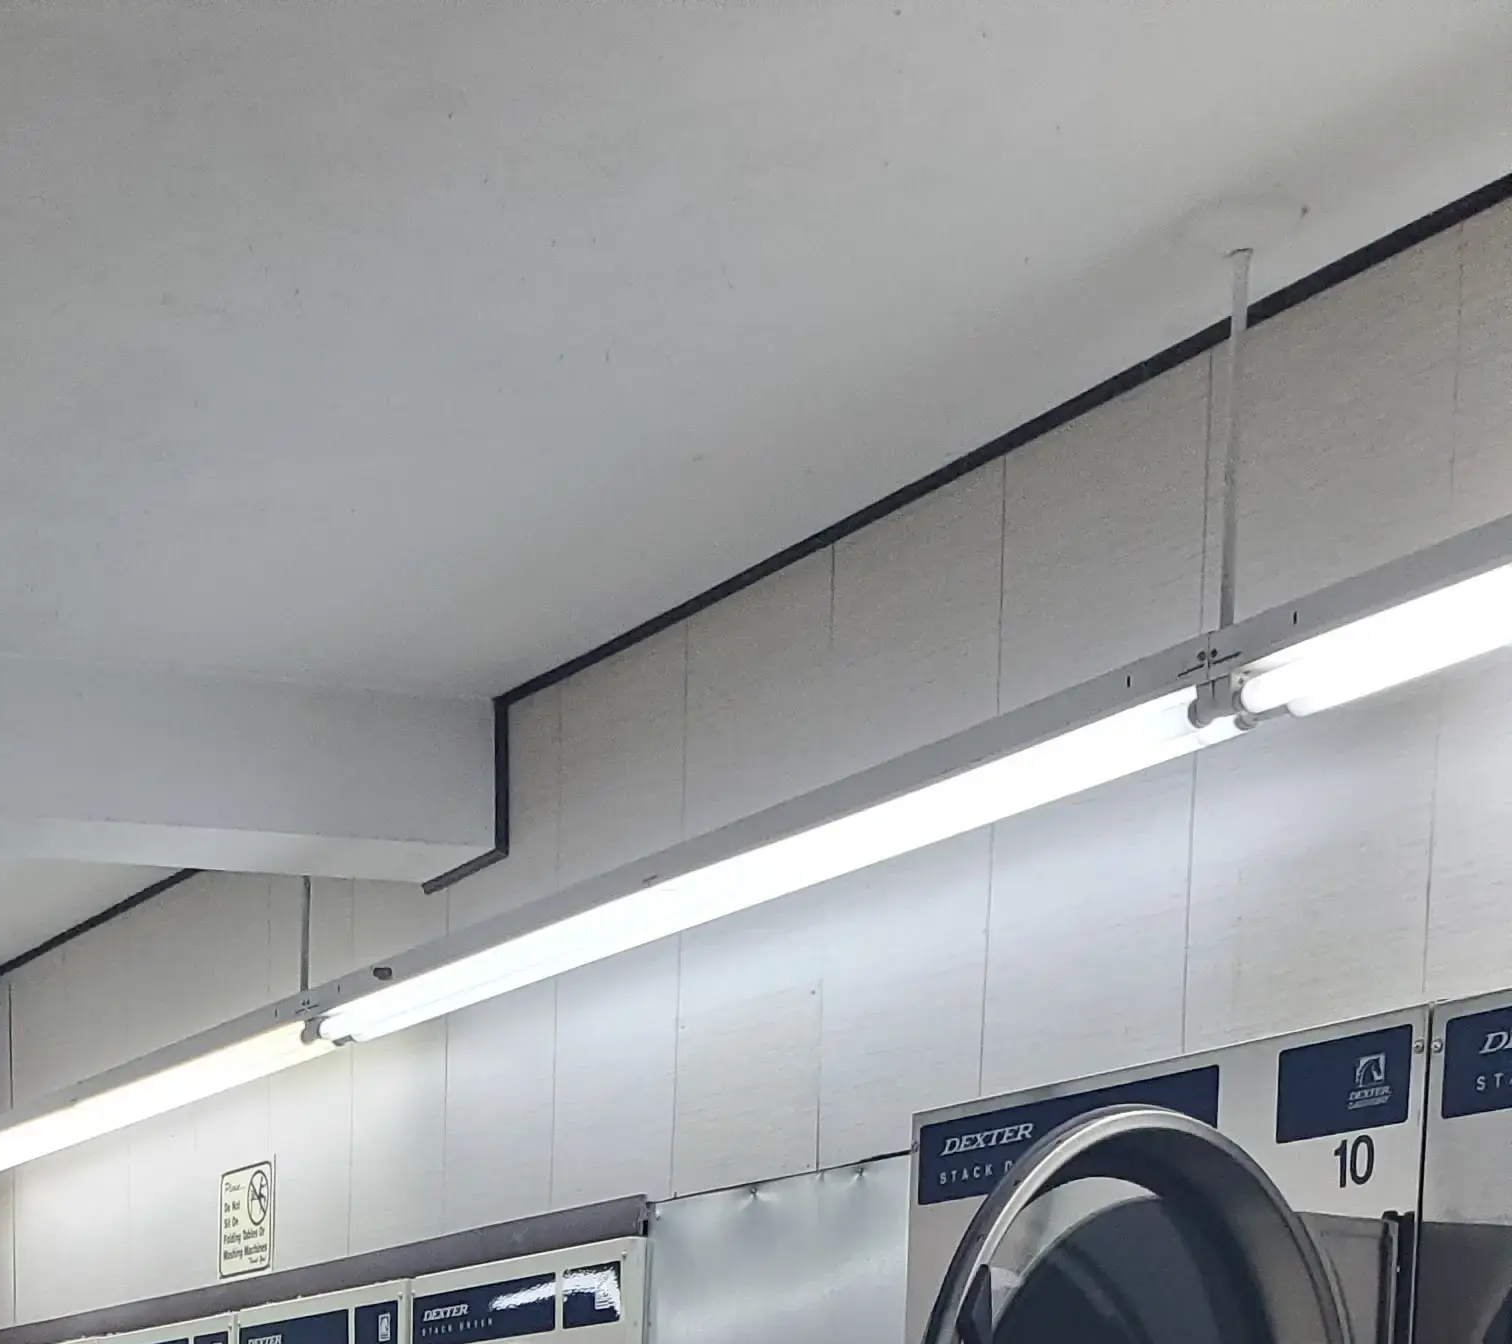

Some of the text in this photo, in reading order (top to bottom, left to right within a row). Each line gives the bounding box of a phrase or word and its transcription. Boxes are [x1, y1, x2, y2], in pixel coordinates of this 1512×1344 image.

[939, 1122, 1034, 1157] DEXTER
[939, 1163, 994, 1185] STACK
[1334, 1134, 1375, 1188] 10
[422, 1303, 469, 1323] DEXTER
